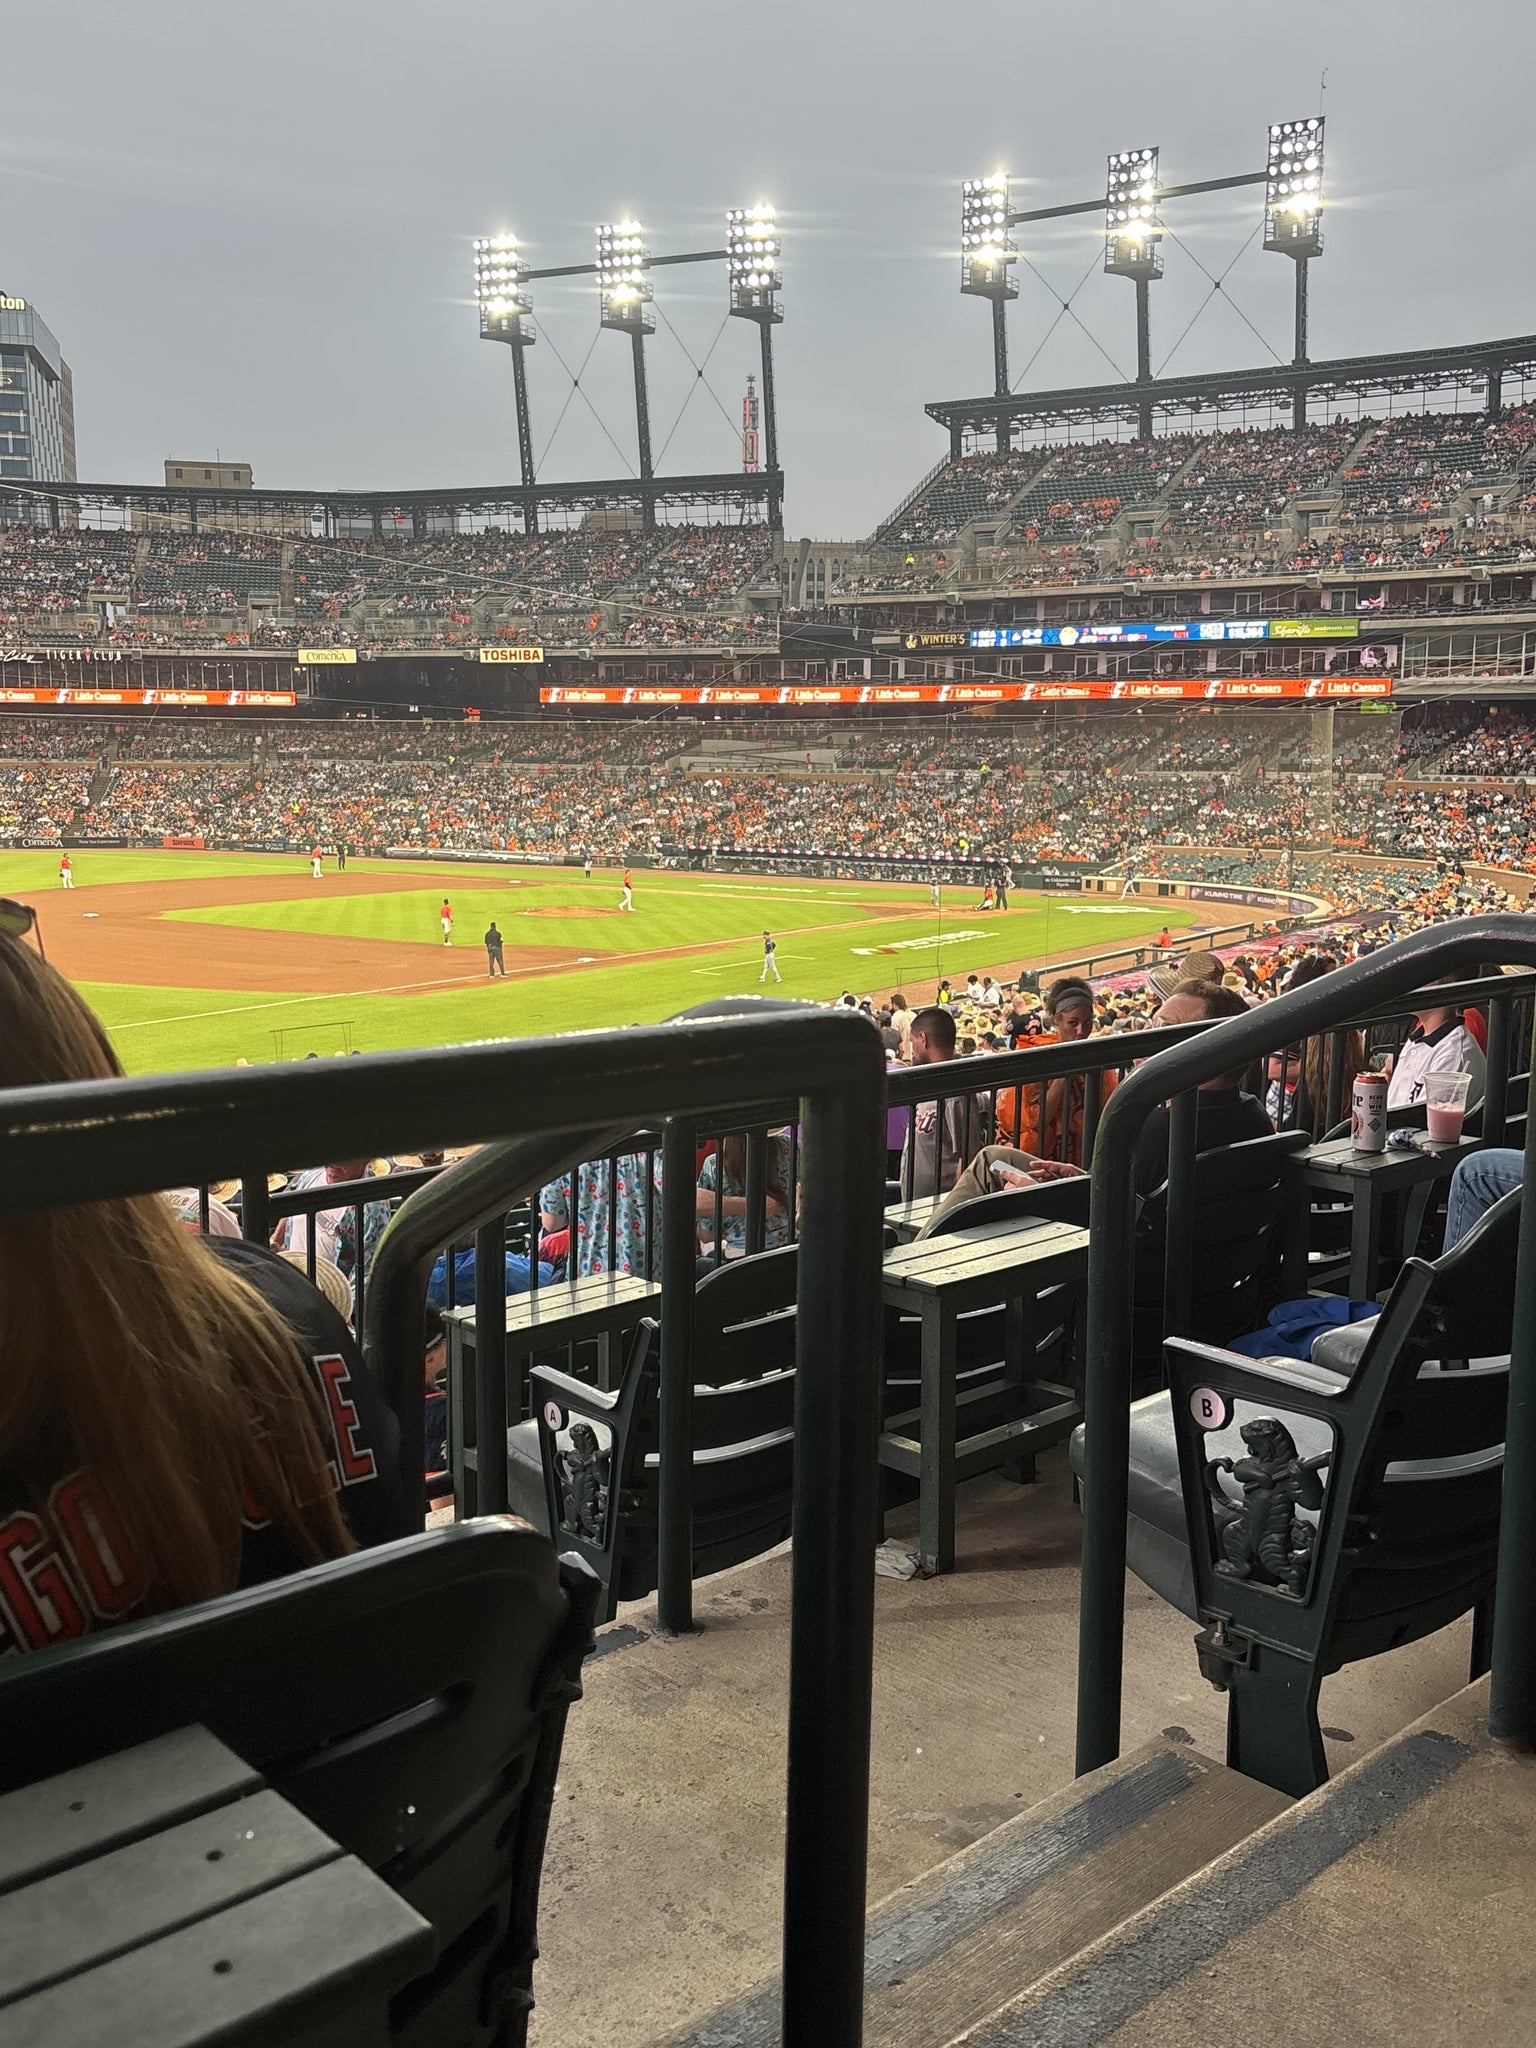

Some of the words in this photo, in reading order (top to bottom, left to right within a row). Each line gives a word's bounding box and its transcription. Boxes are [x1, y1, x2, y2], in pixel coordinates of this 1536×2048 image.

[920, 633, 965, 646] WINTER'S
[3, 649, 43, 664] City
[46, 650, 81, 660] TIGER
[93, 650, 122, 661] CLUB
[482, 649, 541, 661] TOSHIBA
[1131, 685, 1151, 696] Little
[1152, 684, 1183, 695] Caesars
[1226, 683, 1248, 694] Little
[1250, 683, 1282, 694] Caesars
[1327, 682, 1350, 693] Little
[1352, 681, 1386, 692] Caesars
[1205, 890, 1229, 898] KUMHO
[1202, 1399, 1212, 1417] B
[550, 1409, 557, 1423] A
